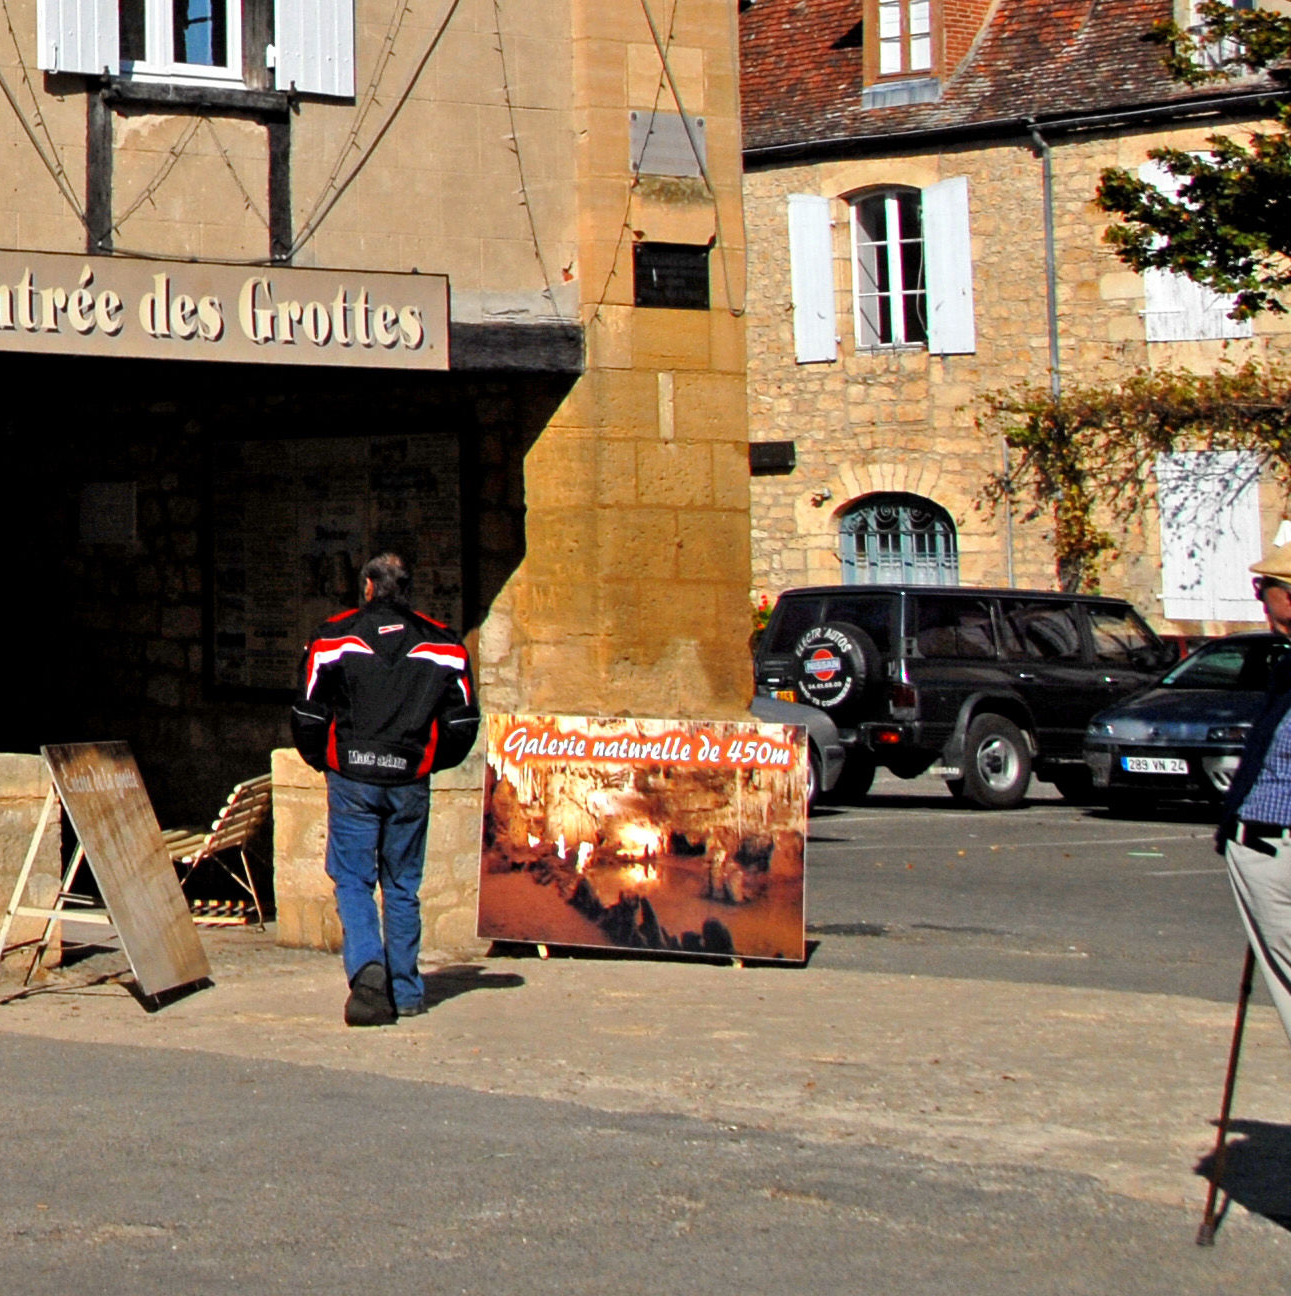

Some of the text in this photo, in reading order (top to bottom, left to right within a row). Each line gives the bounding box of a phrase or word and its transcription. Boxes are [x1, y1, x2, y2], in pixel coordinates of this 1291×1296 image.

[138, 272, 223, 341] des
[238, 275, 424, 350] Grottes
[503, 727, 790, 766] Galerie naturelle de 450m
